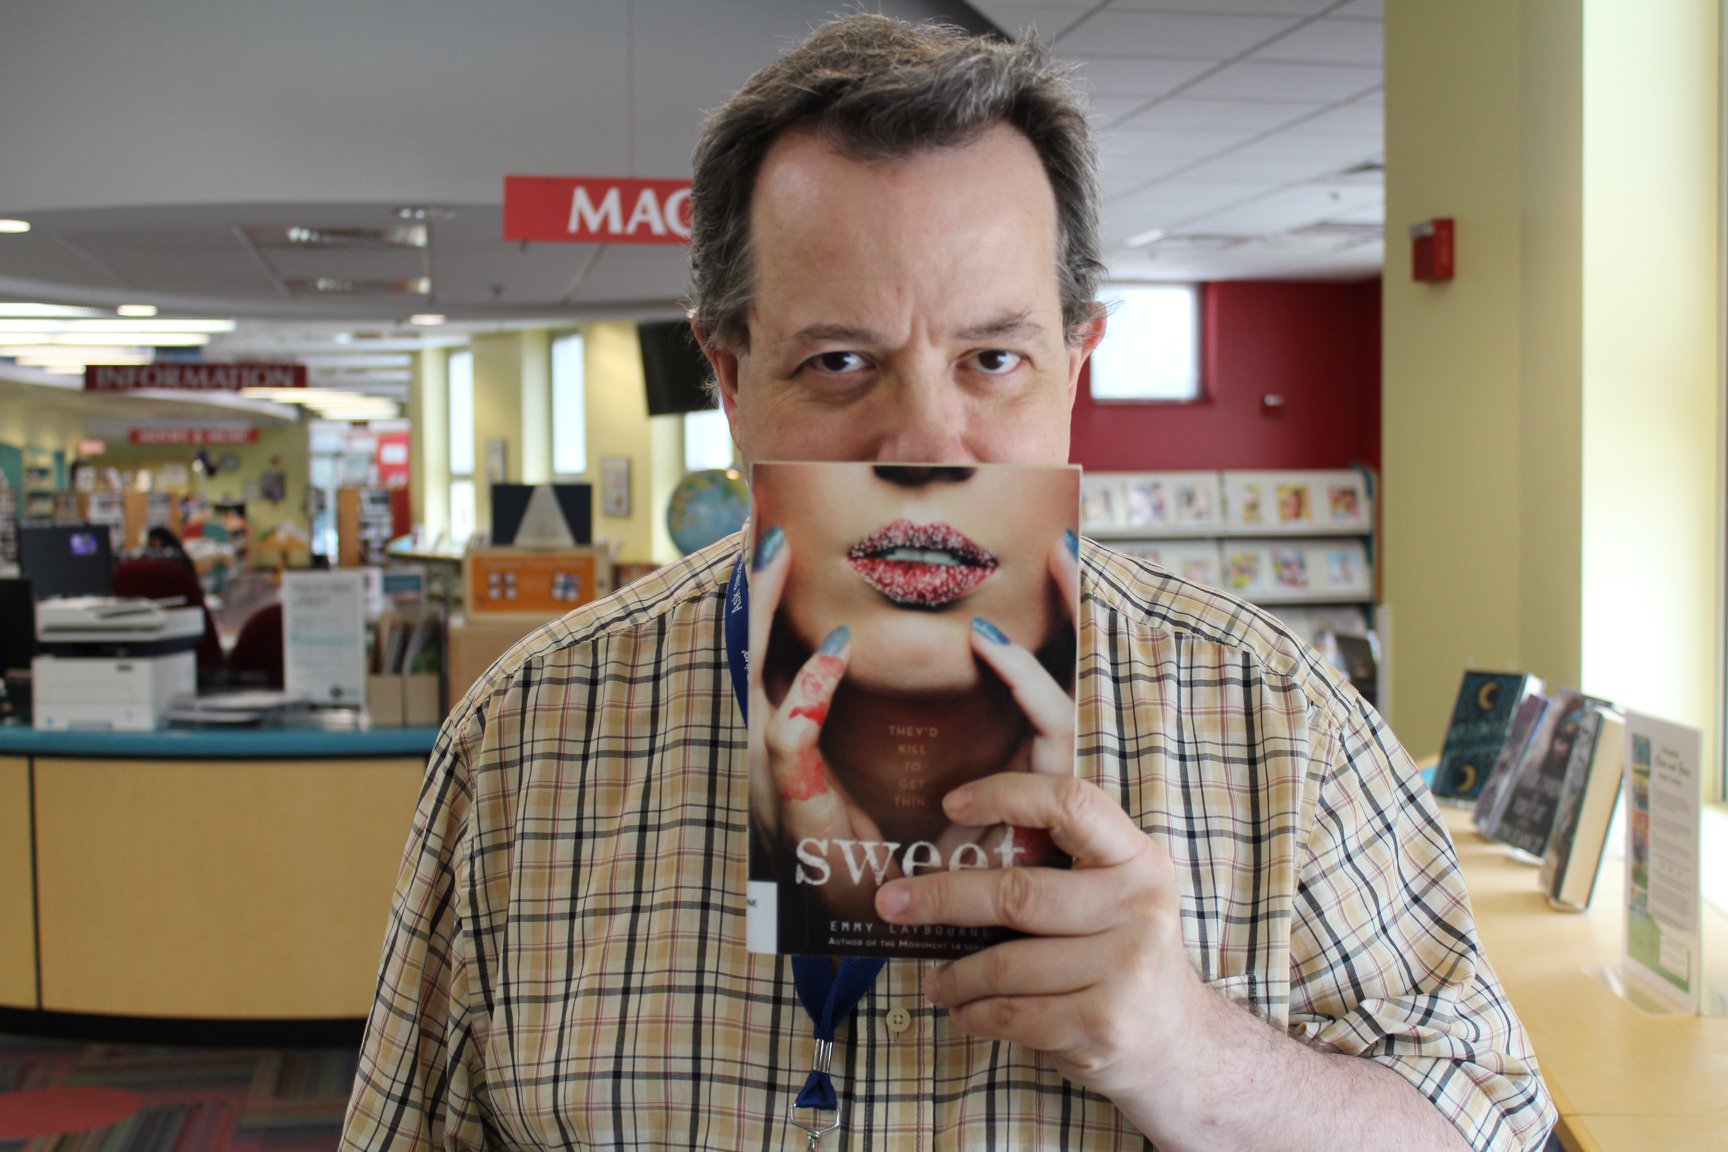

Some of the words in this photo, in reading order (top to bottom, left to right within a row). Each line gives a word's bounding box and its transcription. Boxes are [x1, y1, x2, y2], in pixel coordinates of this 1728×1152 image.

[95, 366, 295, 388] INFORMATION
[888, 725, 939, 738] THEY'D
[898, 744, 926, 755] KILL
[904, 761, 922, 773] TO
[898, 778, 925, 790] GET
[830, 921, 873, 932] EMMY
